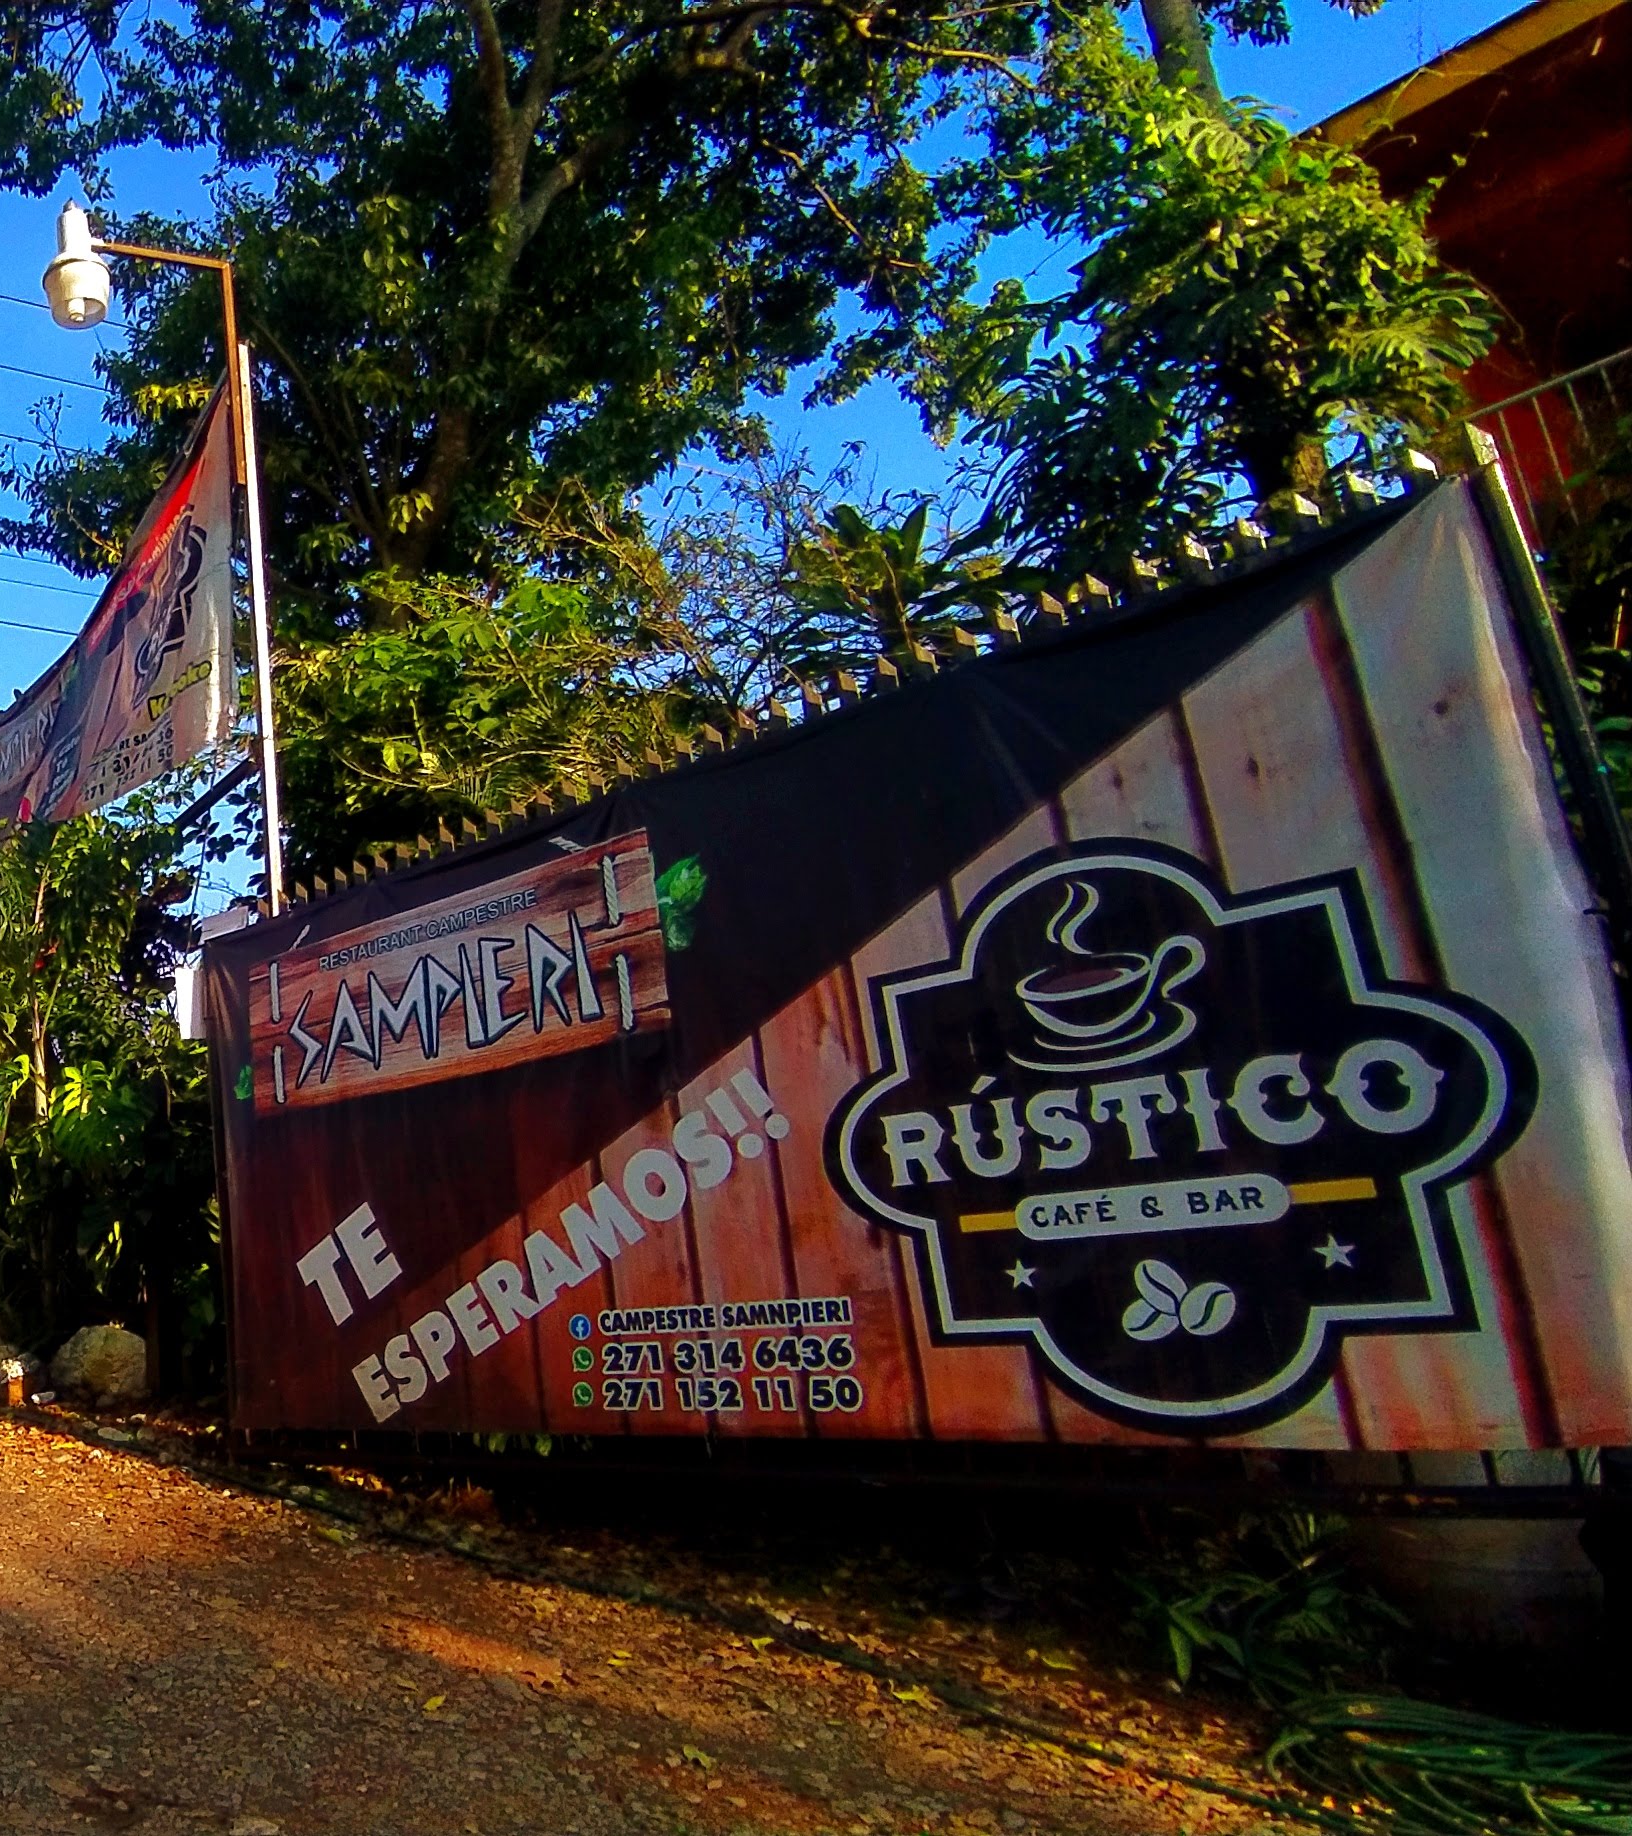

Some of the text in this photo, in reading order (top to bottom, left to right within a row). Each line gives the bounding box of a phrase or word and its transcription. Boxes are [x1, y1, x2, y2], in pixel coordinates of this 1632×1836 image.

[318, 889, 537, 973] RESTAURANT CAMPESTRE
[881, 1039, 1445, 1187] RÚSTICO
[1029, 1185, 1266, 1230] CAFÉ & BAR
[296, 1201, 403, 1326] TE
[351, 1068, 790, 1423] ESPERAMOS!!
[599, 1297, 852, 1336] CAMPESTRE SAMNPIERI
[603, 1334, 856, 1375] 271 314 6436
[603, 1375, 864, 1412] 271 152 11 50
